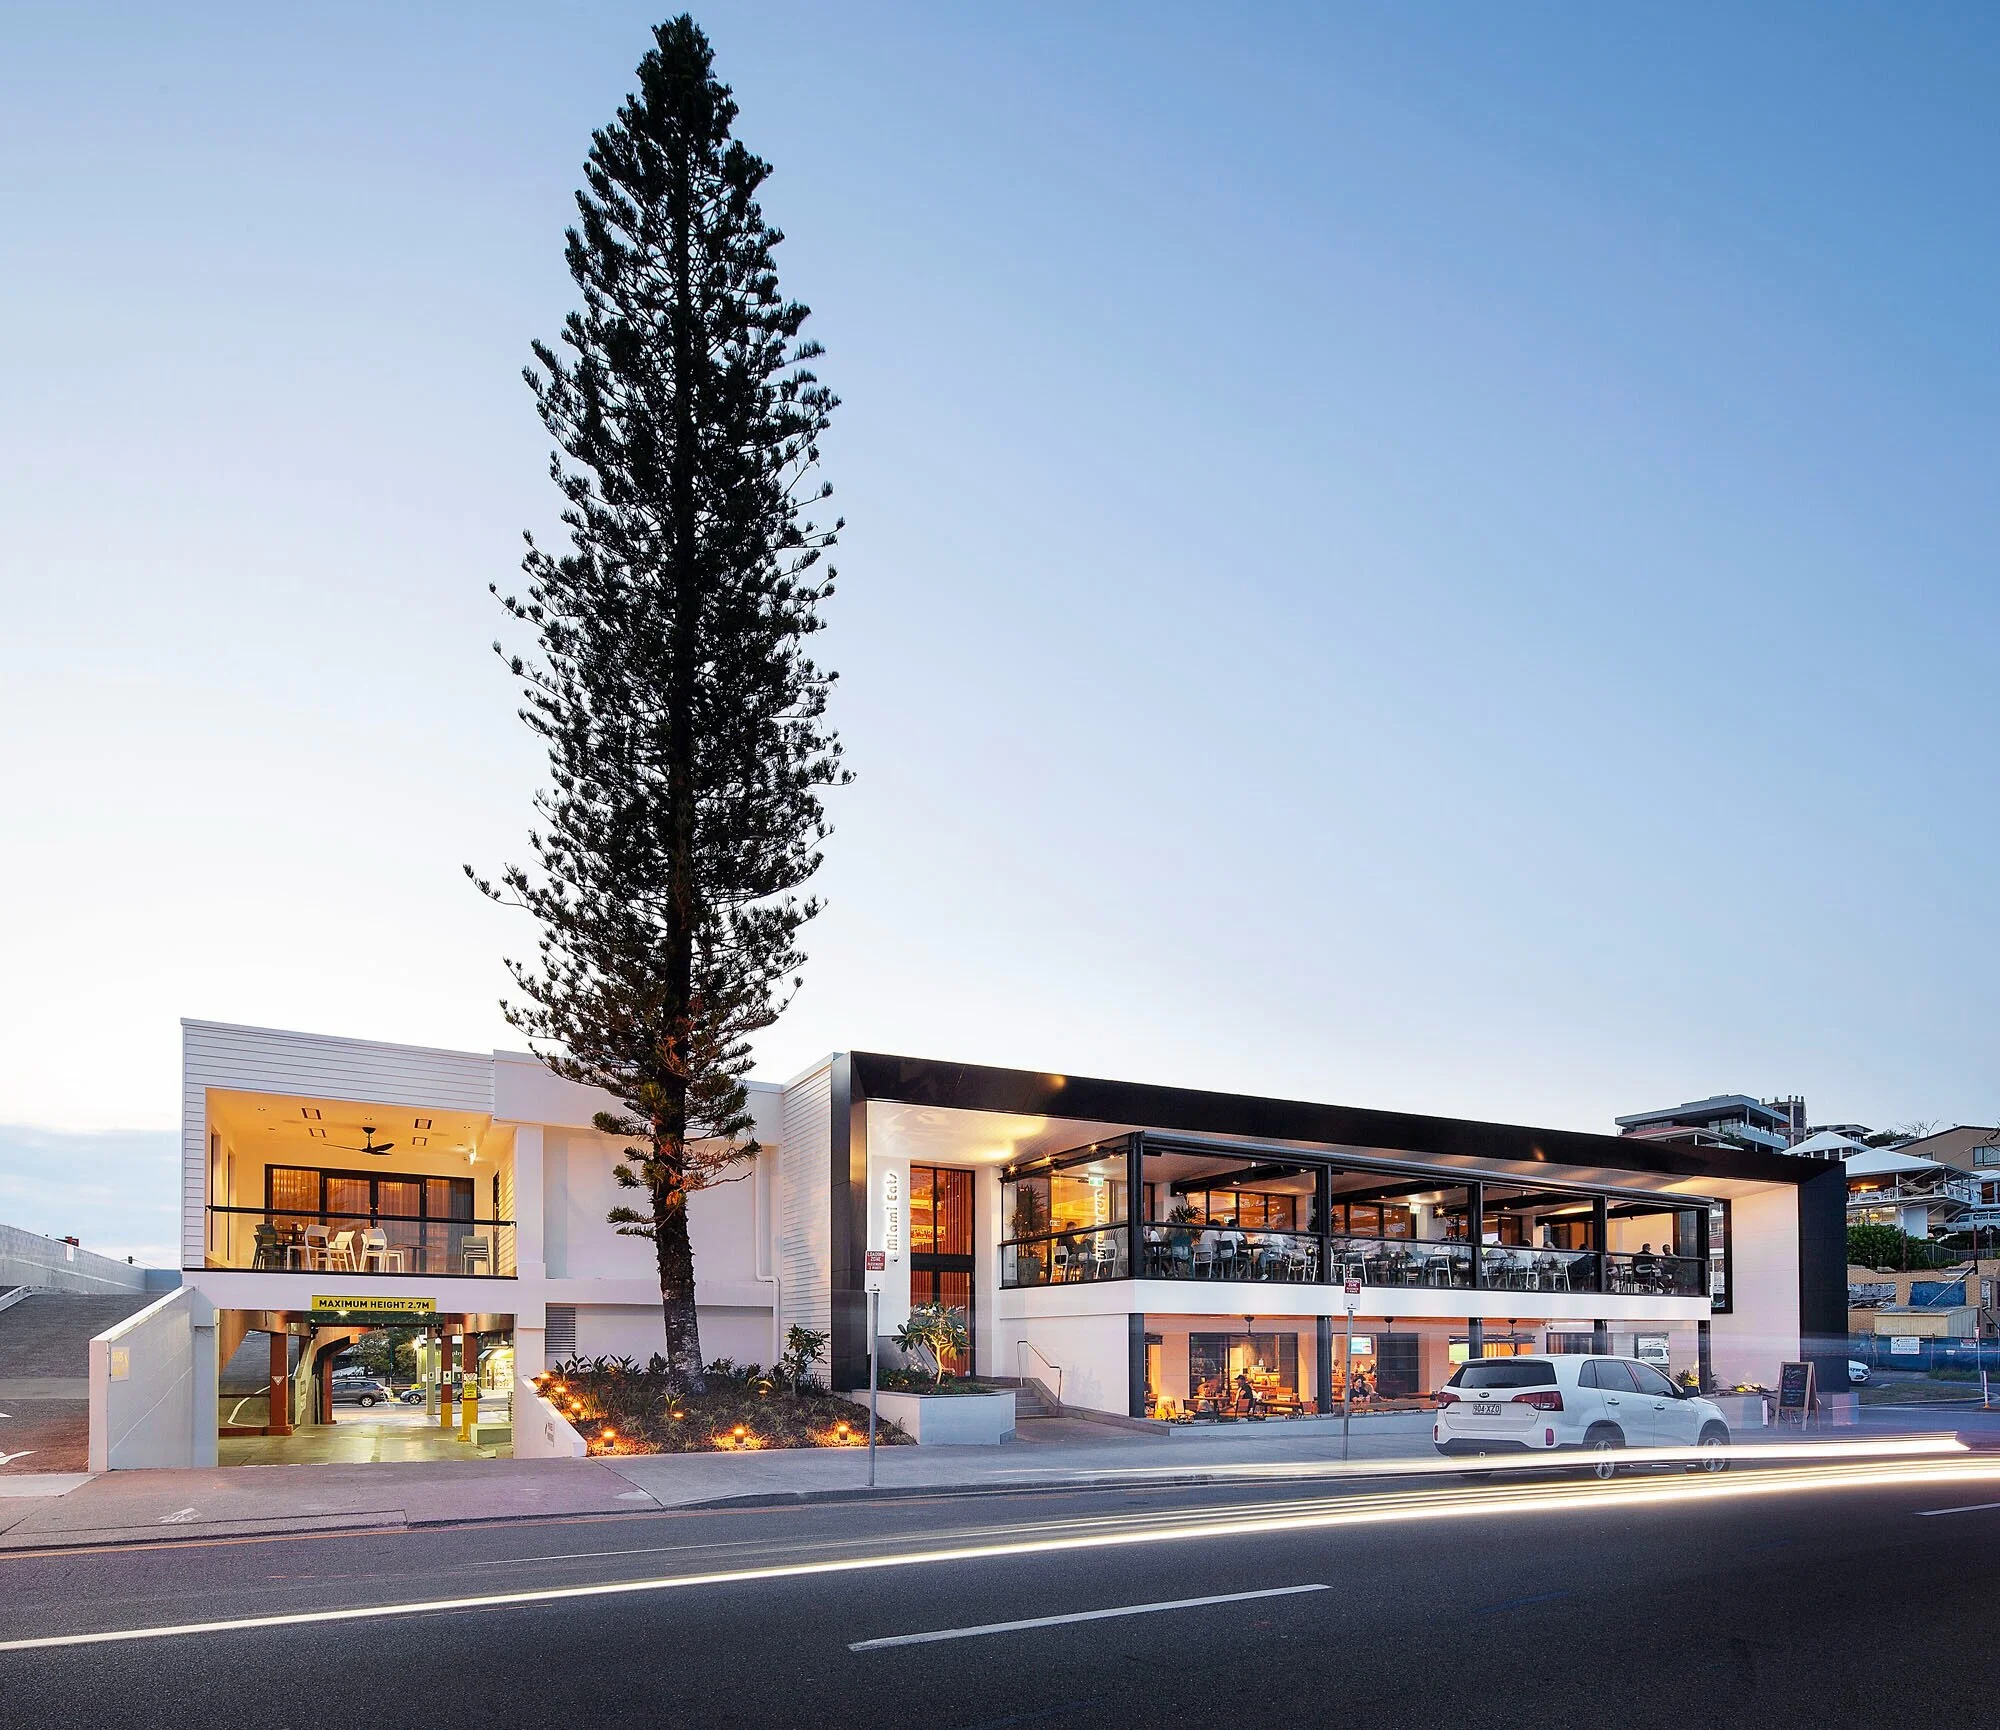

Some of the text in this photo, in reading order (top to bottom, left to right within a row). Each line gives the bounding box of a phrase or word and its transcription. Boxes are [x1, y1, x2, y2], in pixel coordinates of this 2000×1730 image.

[886, 1173, 898, 1250] Miami Eats
[319, 1300, 368, 1308] MAXIMUM
[370, 1301, 405, 1309] HEIGHT
